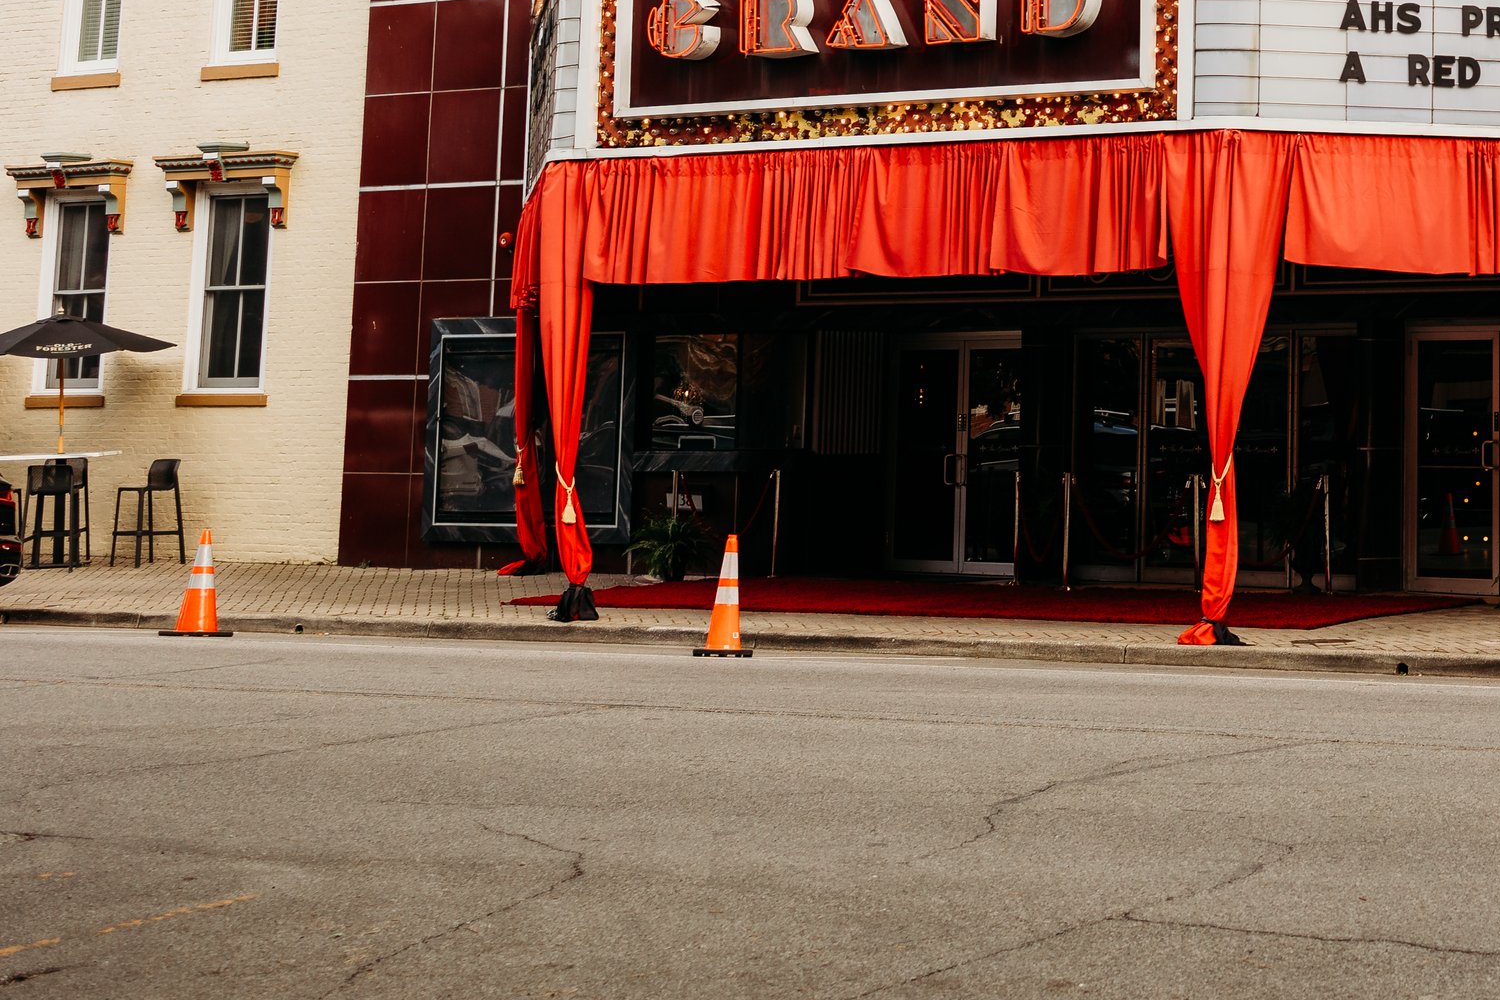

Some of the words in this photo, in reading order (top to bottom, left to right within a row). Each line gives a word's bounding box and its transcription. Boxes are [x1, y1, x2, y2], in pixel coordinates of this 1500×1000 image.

[1340, 0, 1421, 35] AHS
[1339, 51, 1366, 84] A
[1408, 56, 1482, 89] RED
[35, 343, 93, 351] FORESTER
